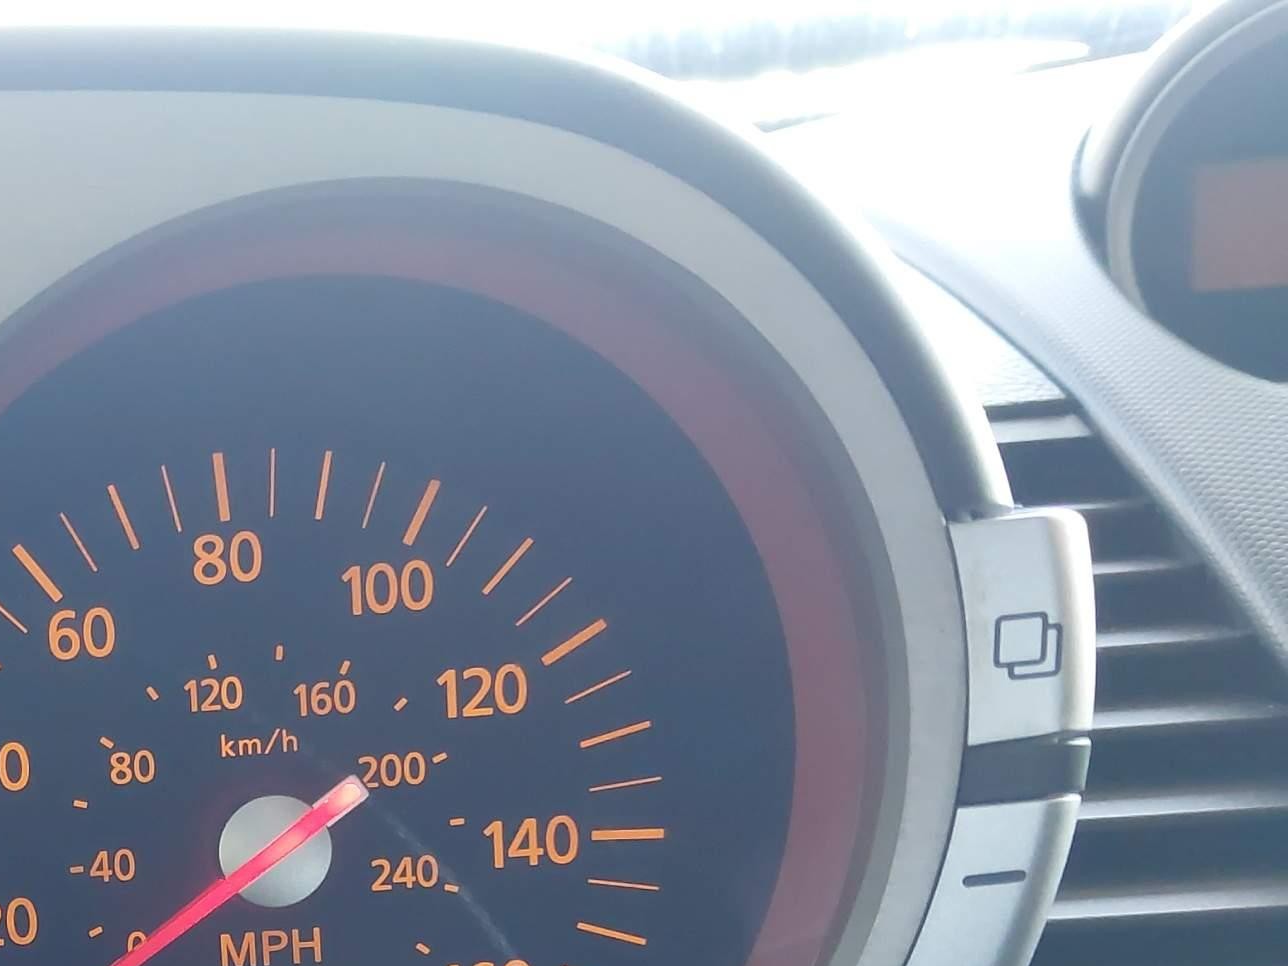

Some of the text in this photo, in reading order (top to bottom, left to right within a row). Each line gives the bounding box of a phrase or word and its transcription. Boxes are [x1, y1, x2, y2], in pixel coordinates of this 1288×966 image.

[191, 531, 263, 586] 80
[341, 560, 434, 616] 100
[47, 607, 116, 661] 60
[184, 676, 243, 711] 120
[294, 680, 357, 715] 160
[436, 664, 527, 719] 120
[219, 729, 298, 758] km/h
[110, 751, 155, 784] 80
[358, 752, 426, 788] 200
[483, 817, 579, 869] 140
[90, 849, 136, 883] 40
[370, 854, 438, 891] 240
